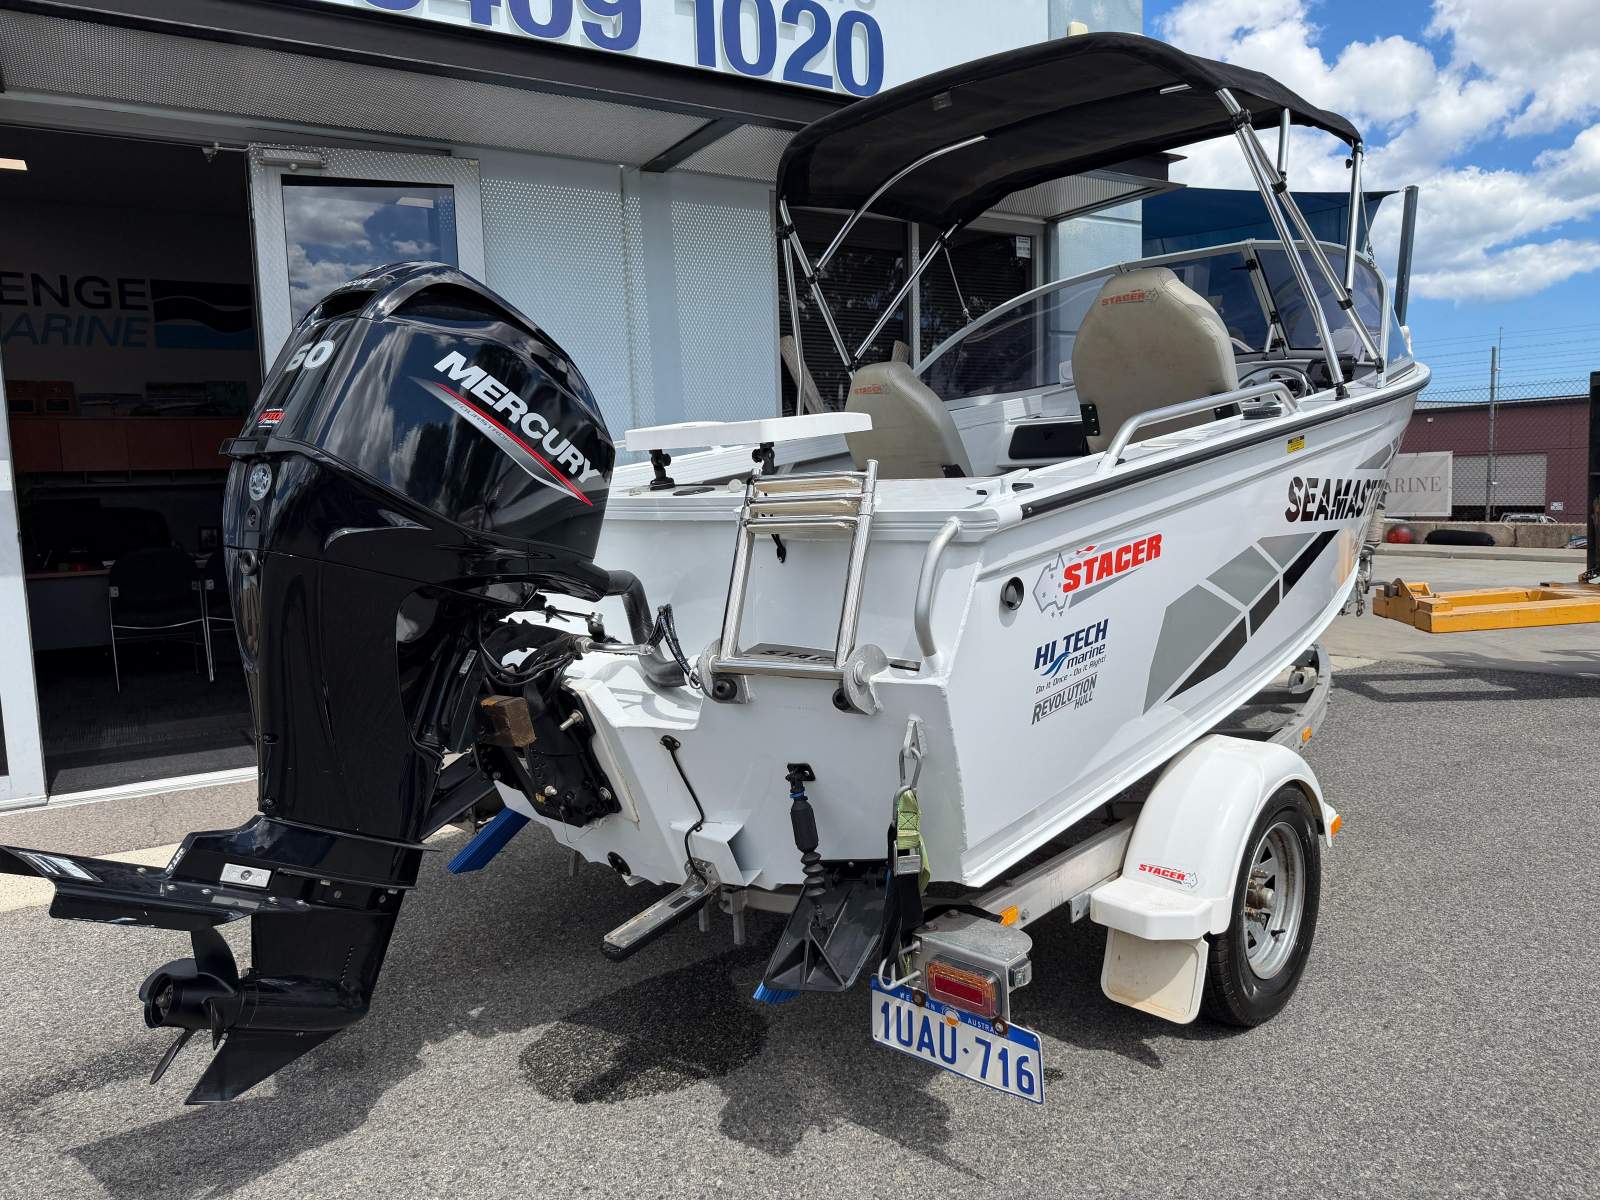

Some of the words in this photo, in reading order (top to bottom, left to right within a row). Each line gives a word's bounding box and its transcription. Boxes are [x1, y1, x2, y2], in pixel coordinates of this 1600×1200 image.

[695, 0, 885, 97] 1020
[0, 271, 148, 311] ENGE
[1102, 291, 1147, 305] STACER
[434, 351, 600, 483] MERCURY
[1062, 533, 1163, 593] STACER
[1034, 640, 1058, 670] HI
[1063, 618, 1109, 653] TECH
[1066, 644, 1106, 669] marine
[1139, 864, 1185, 881] STACER
[900, 991, 936, 1011] WERN
[967, 1016, 1001, 1036] AUSTRA
